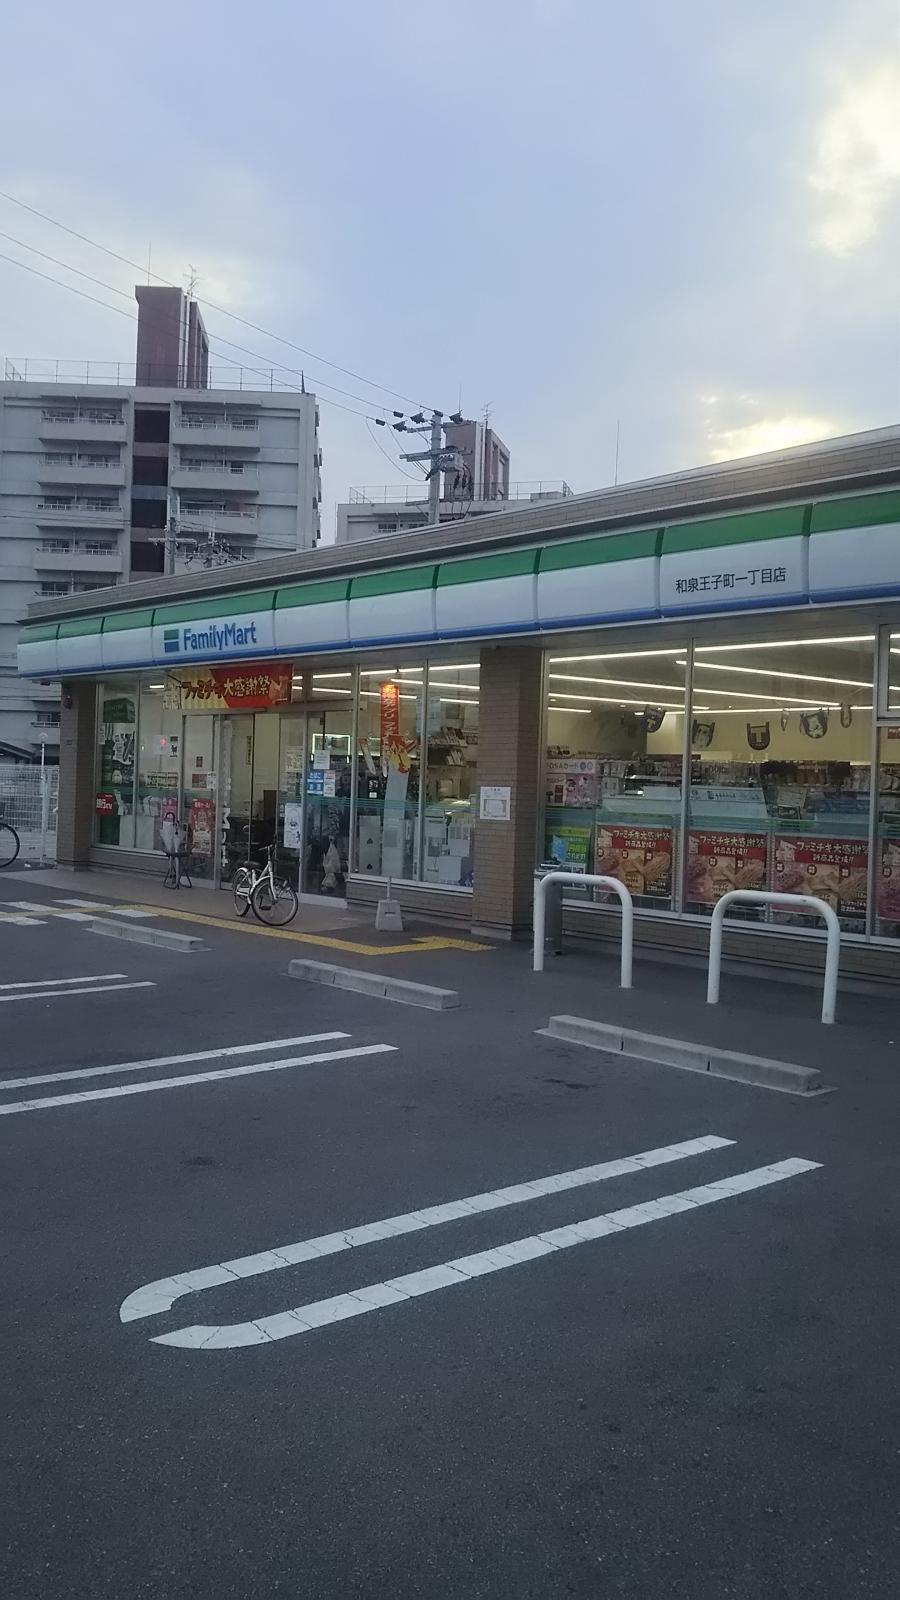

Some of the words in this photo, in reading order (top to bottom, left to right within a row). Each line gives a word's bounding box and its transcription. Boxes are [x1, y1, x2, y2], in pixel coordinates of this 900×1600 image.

[675, 567, 787, 593] 和泉王子町一丁目店
[184, 621, 257, 651] FamilyMart
